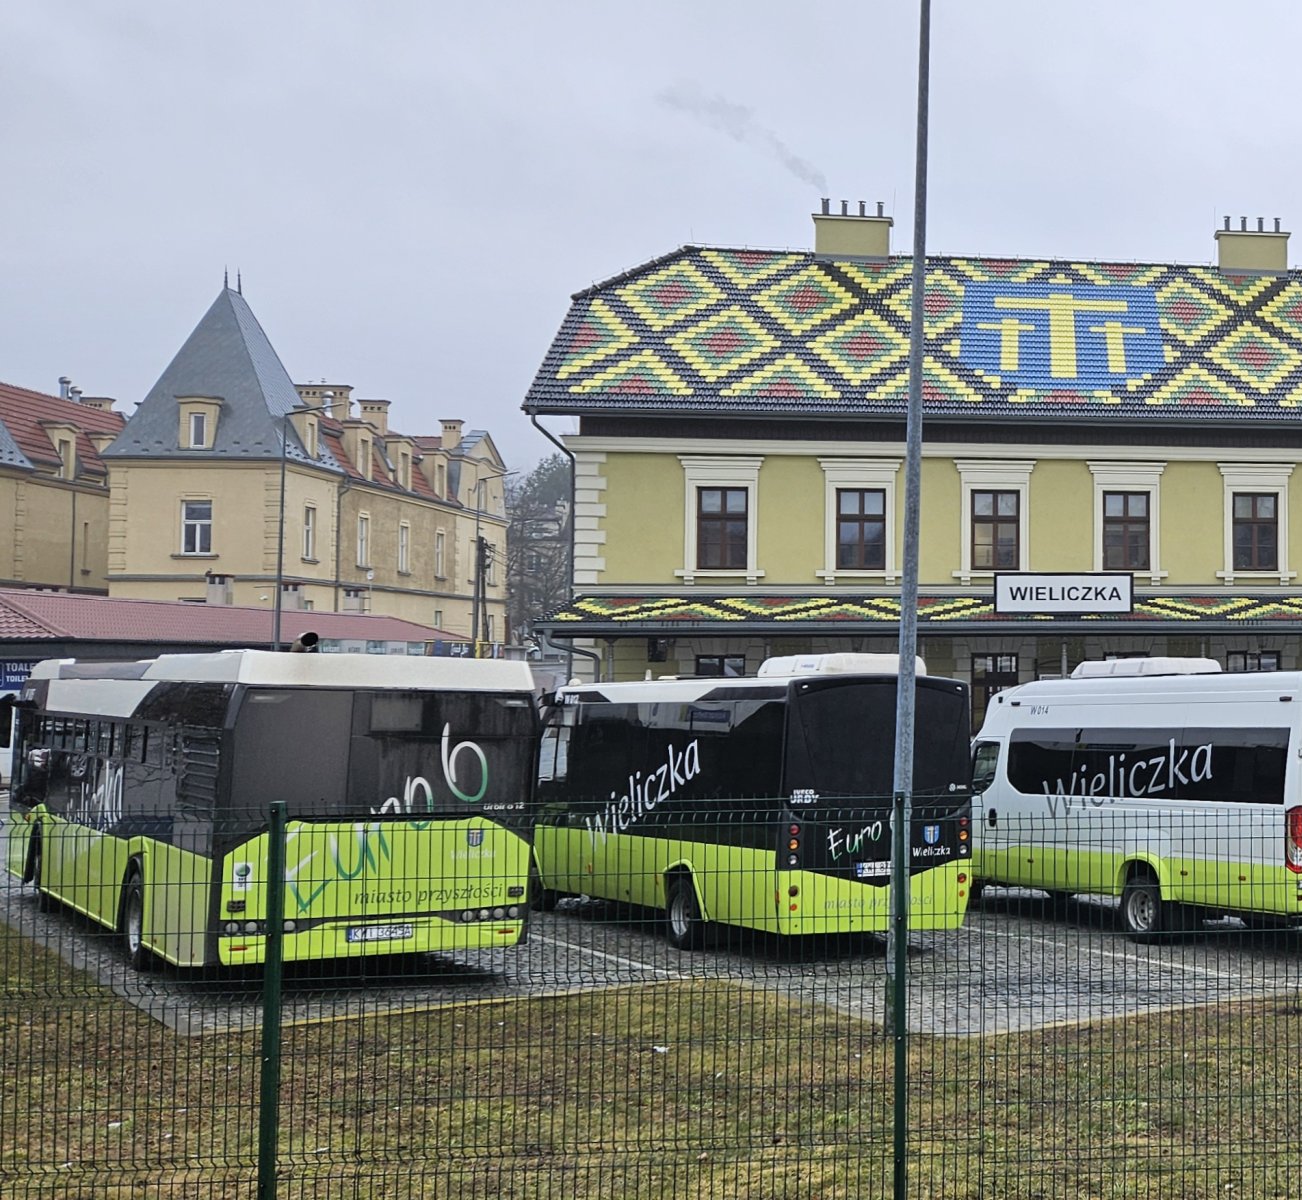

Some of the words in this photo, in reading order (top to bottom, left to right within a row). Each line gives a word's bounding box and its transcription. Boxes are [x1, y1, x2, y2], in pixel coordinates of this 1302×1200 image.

[1009, 586, 1122, 601] WIELICZKA
[6, 662, 39, 672] TOALE
[6, 675, 29, 683] TOILE
[441, 721, 488, 802] 6
[1042, 737, 1213, 819] Wieliczka
[585, 738, 701, 852] Wieliczka
[514, 801, 525, 810] 12
[827, 820, 883, 861] Euro
[354, 888, 412, 905] miasto
[416, 882, 503, 906] przyszłości
[824, 896, 865, 910] masto
